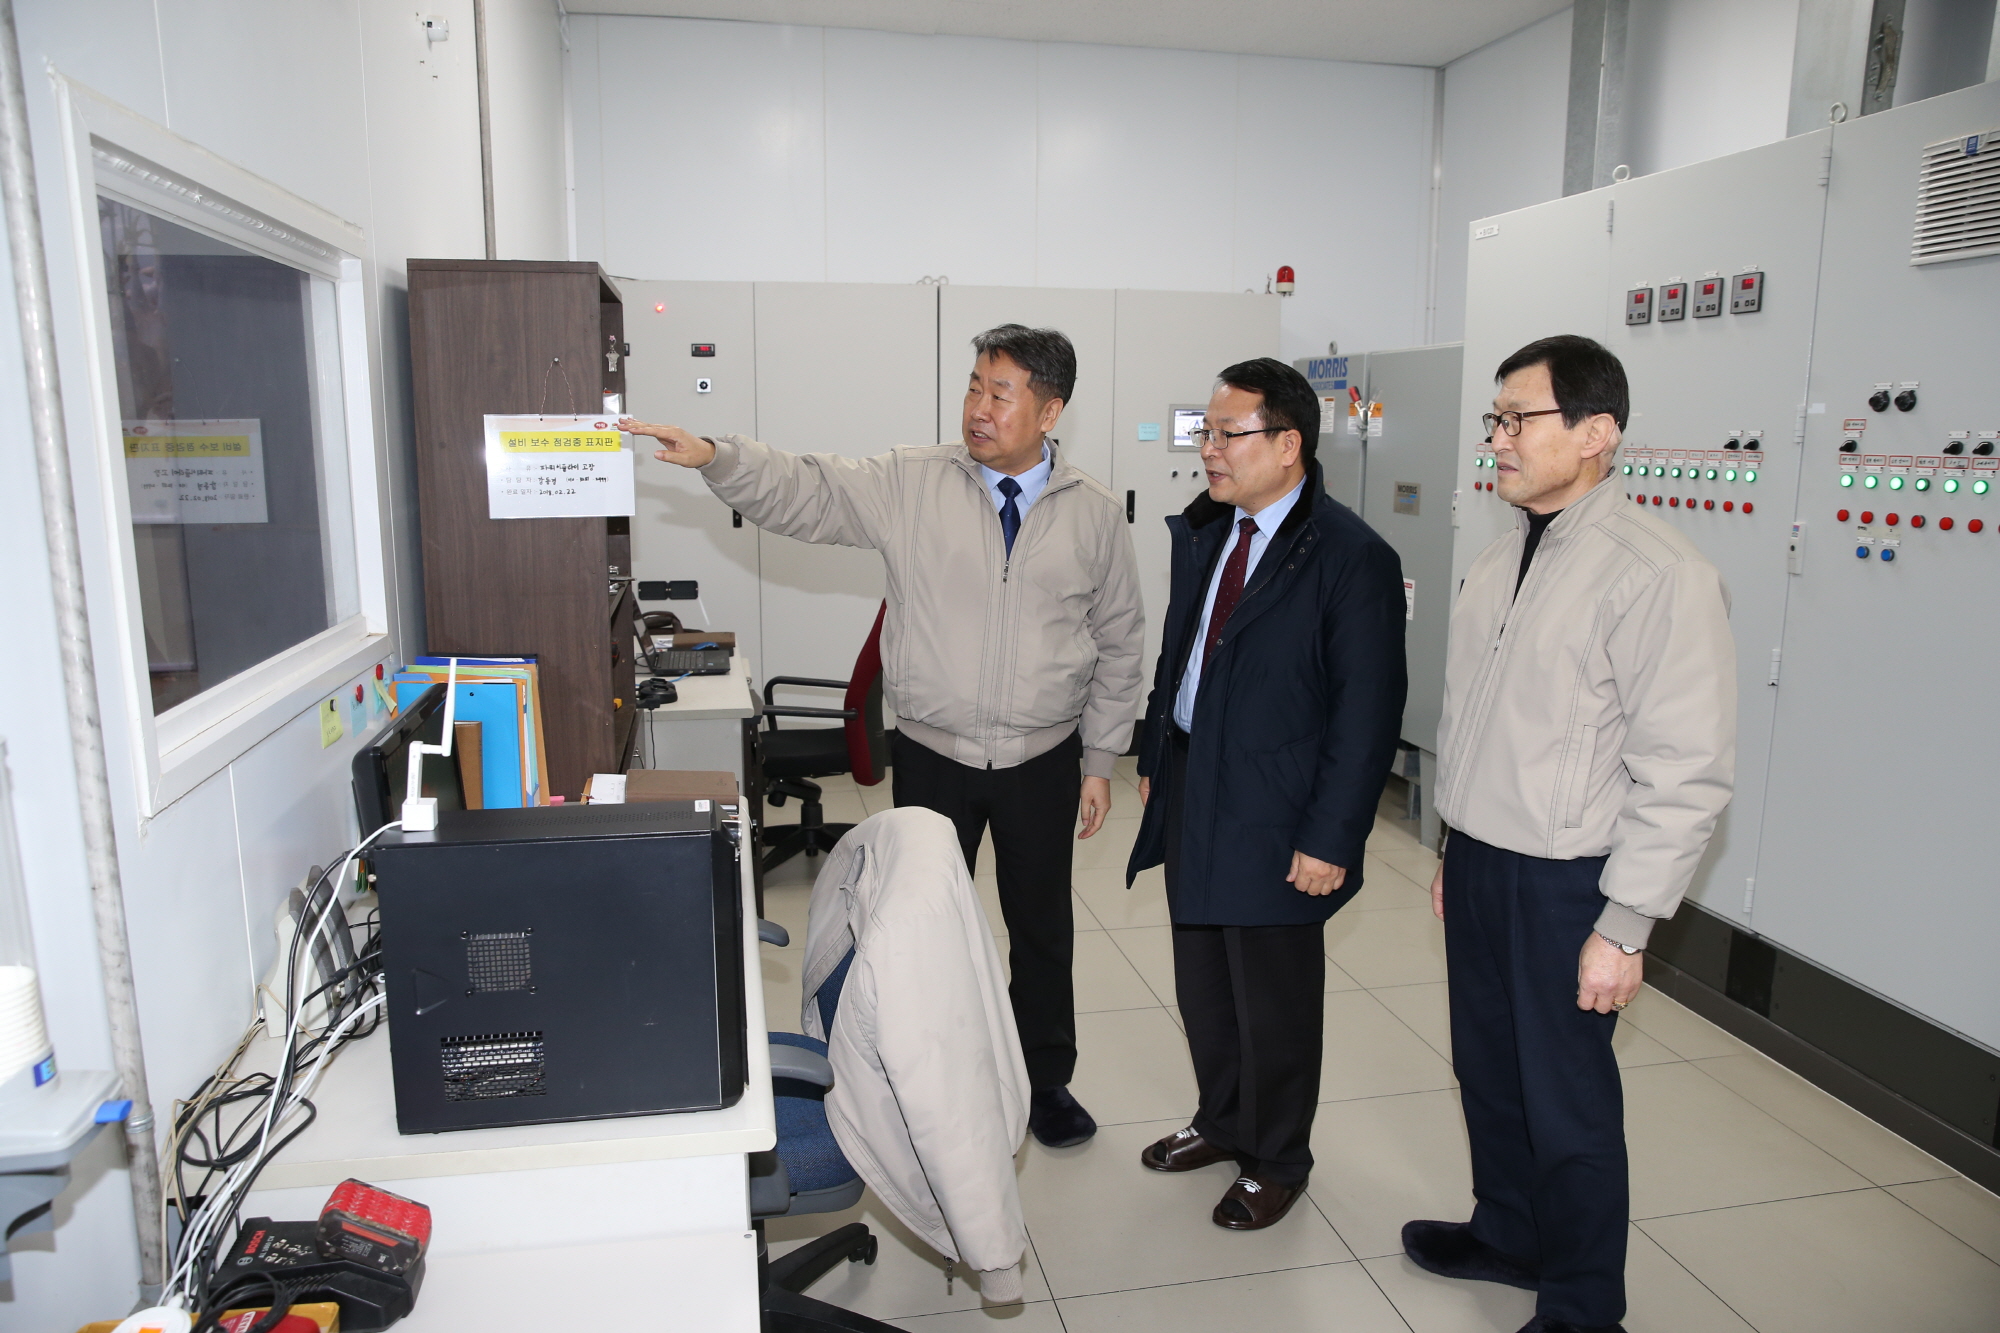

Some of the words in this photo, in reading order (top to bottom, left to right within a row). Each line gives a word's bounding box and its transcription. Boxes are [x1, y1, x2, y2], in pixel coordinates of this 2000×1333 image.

[1308, 357, 1348, 379] MORRIS
[508, 438, 526, 447] 설비
[531, 438, 549, 447] 보수
[585, 437, 613, 447] 표지판
[582, 463, 595, 471] 고장
[244, 1230, 266, 1254] BOSCH
